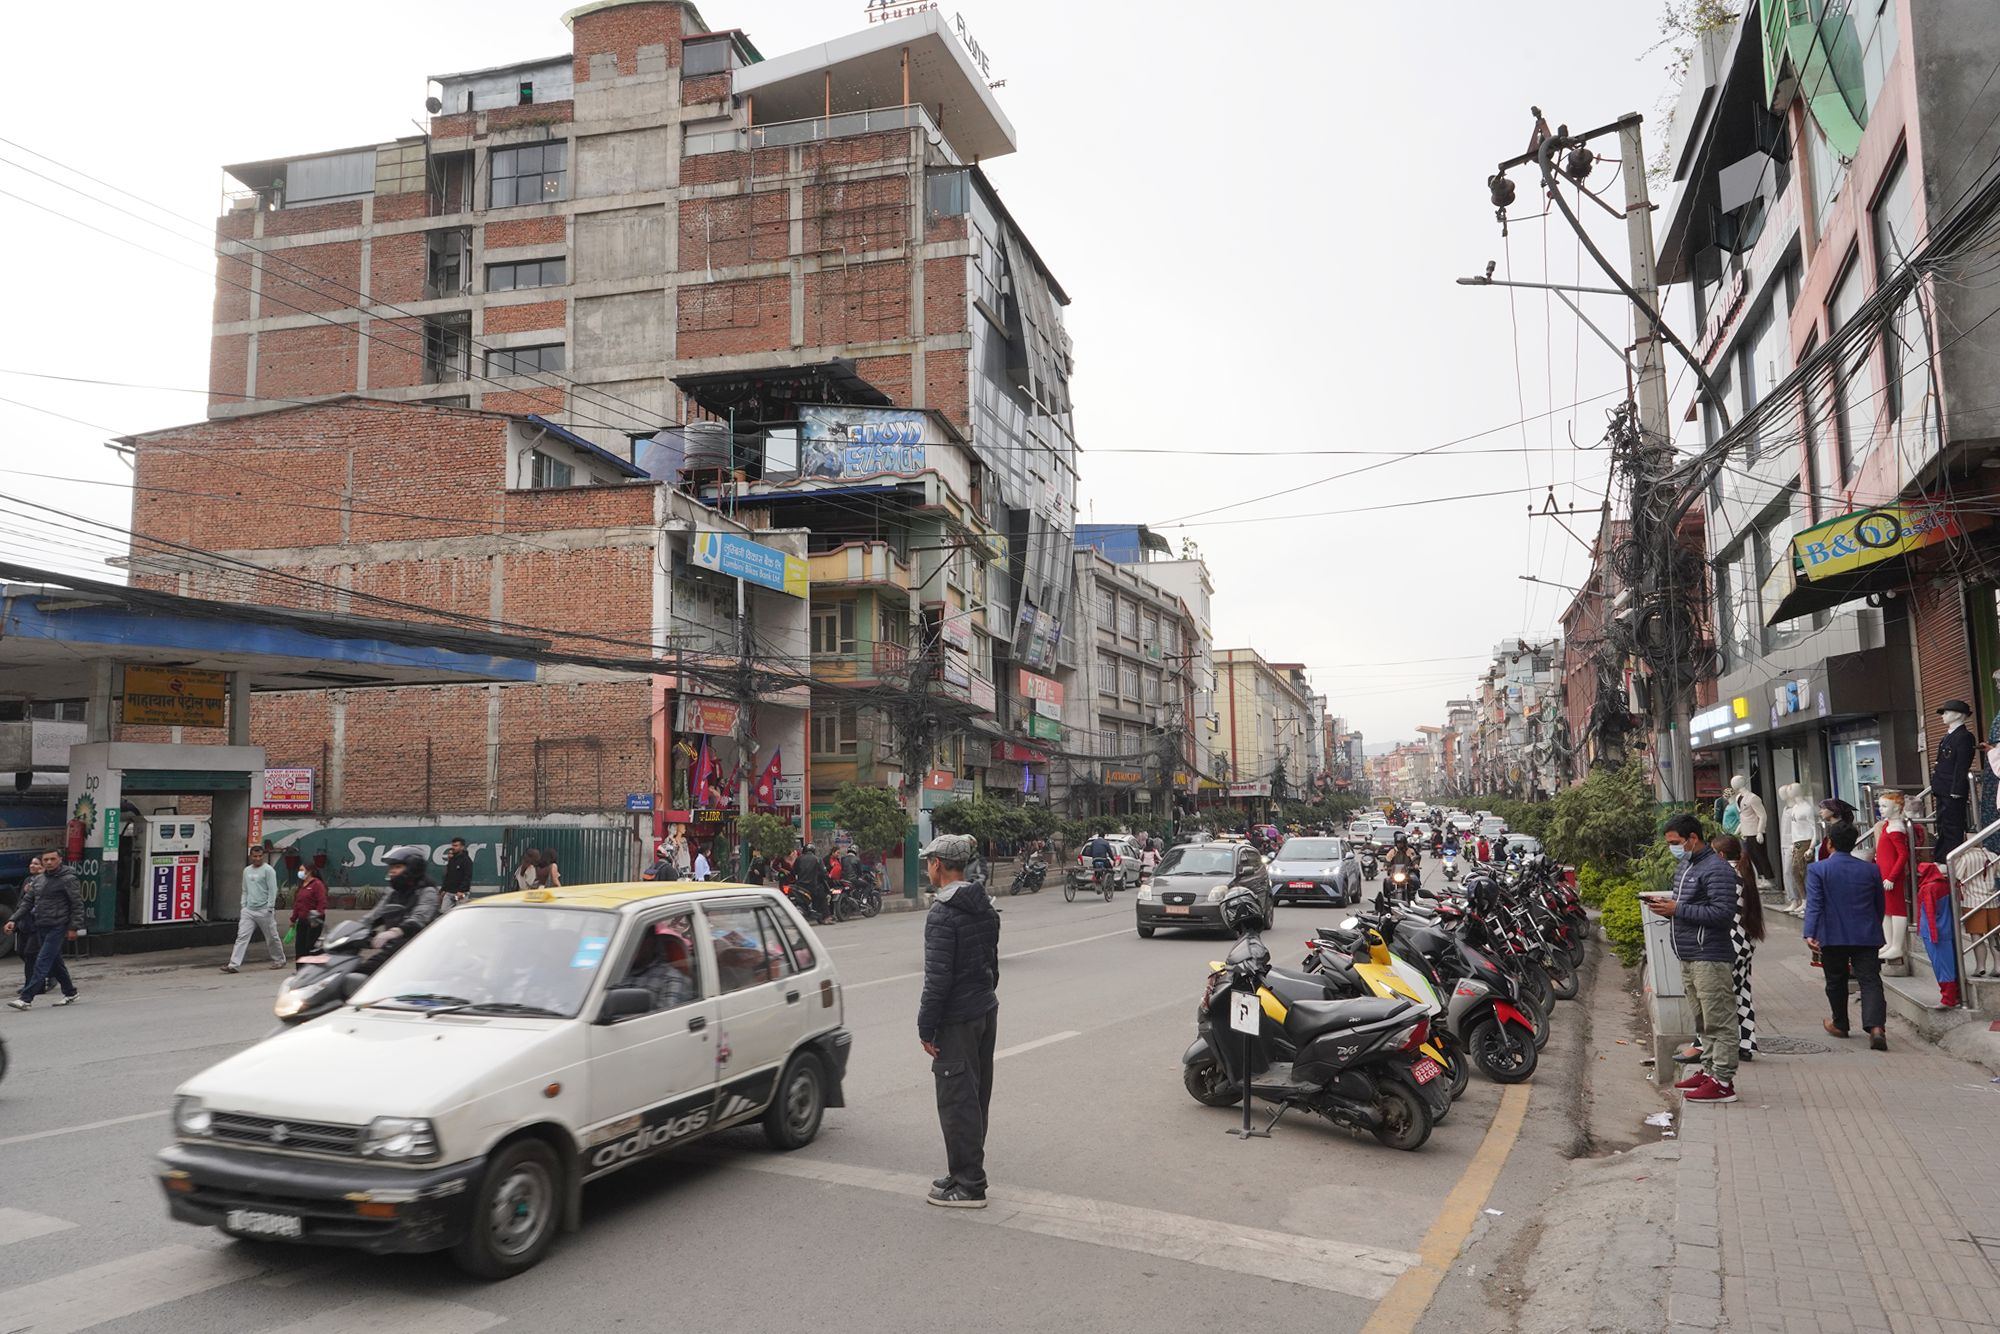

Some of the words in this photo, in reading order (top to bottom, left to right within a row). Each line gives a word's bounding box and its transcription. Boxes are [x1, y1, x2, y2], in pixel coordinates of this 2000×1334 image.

[869, 2, 938, 23] Lounge
[759, 568, 772, 580] Bank
[86, 773, 99, 791] bp
[108, 810, 116, 847] DIESEL
[252, 809, 260, 843] PETROL
[157, 867, 170, 920] DIESEL
[180, 866, 192, 918] PETROL
[591, 1109, 710, 1167] adidas
